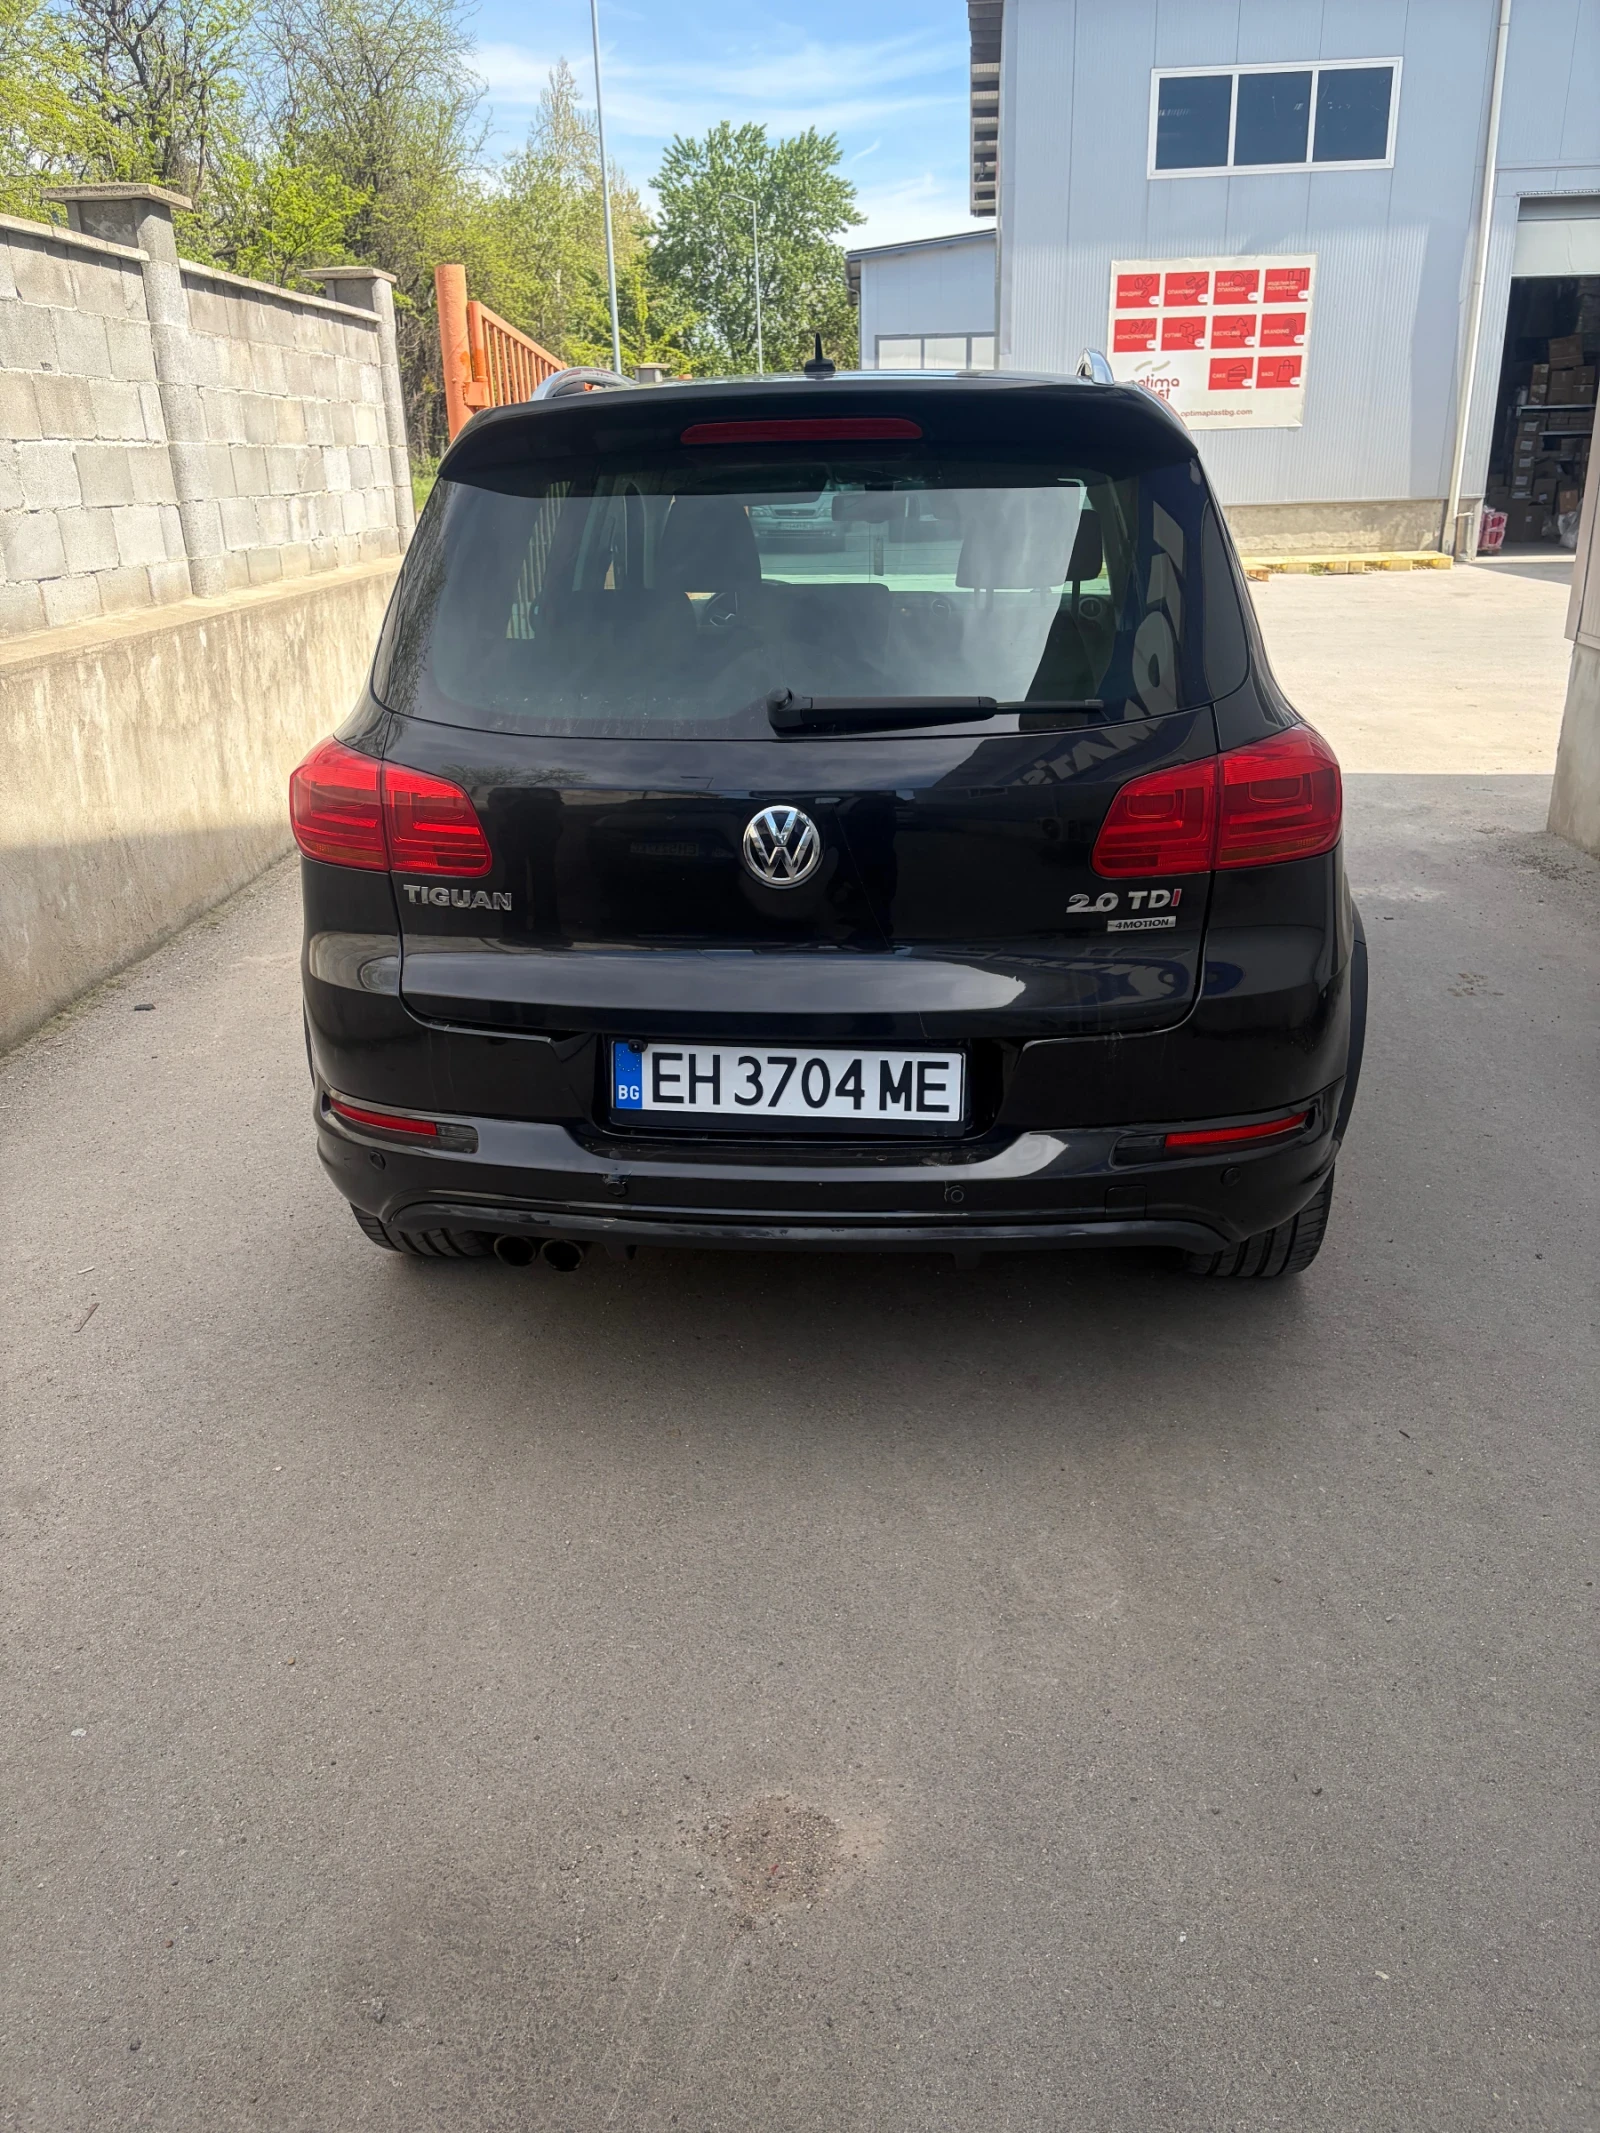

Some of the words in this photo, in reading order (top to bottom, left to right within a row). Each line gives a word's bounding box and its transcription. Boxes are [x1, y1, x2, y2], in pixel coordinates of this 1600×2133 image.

[403, 884, 512, 911] TIGUAN
[1128, 889, 1182, 910] TDI
[1115, 918, 1169, 930] 4MOTION
[618, 1084, 640, 1100] BG
[652, 1052, 721, 1105] EH
[734, 1056, 865, 1110] 3704
[879, 1060, 950, 1113] ME
